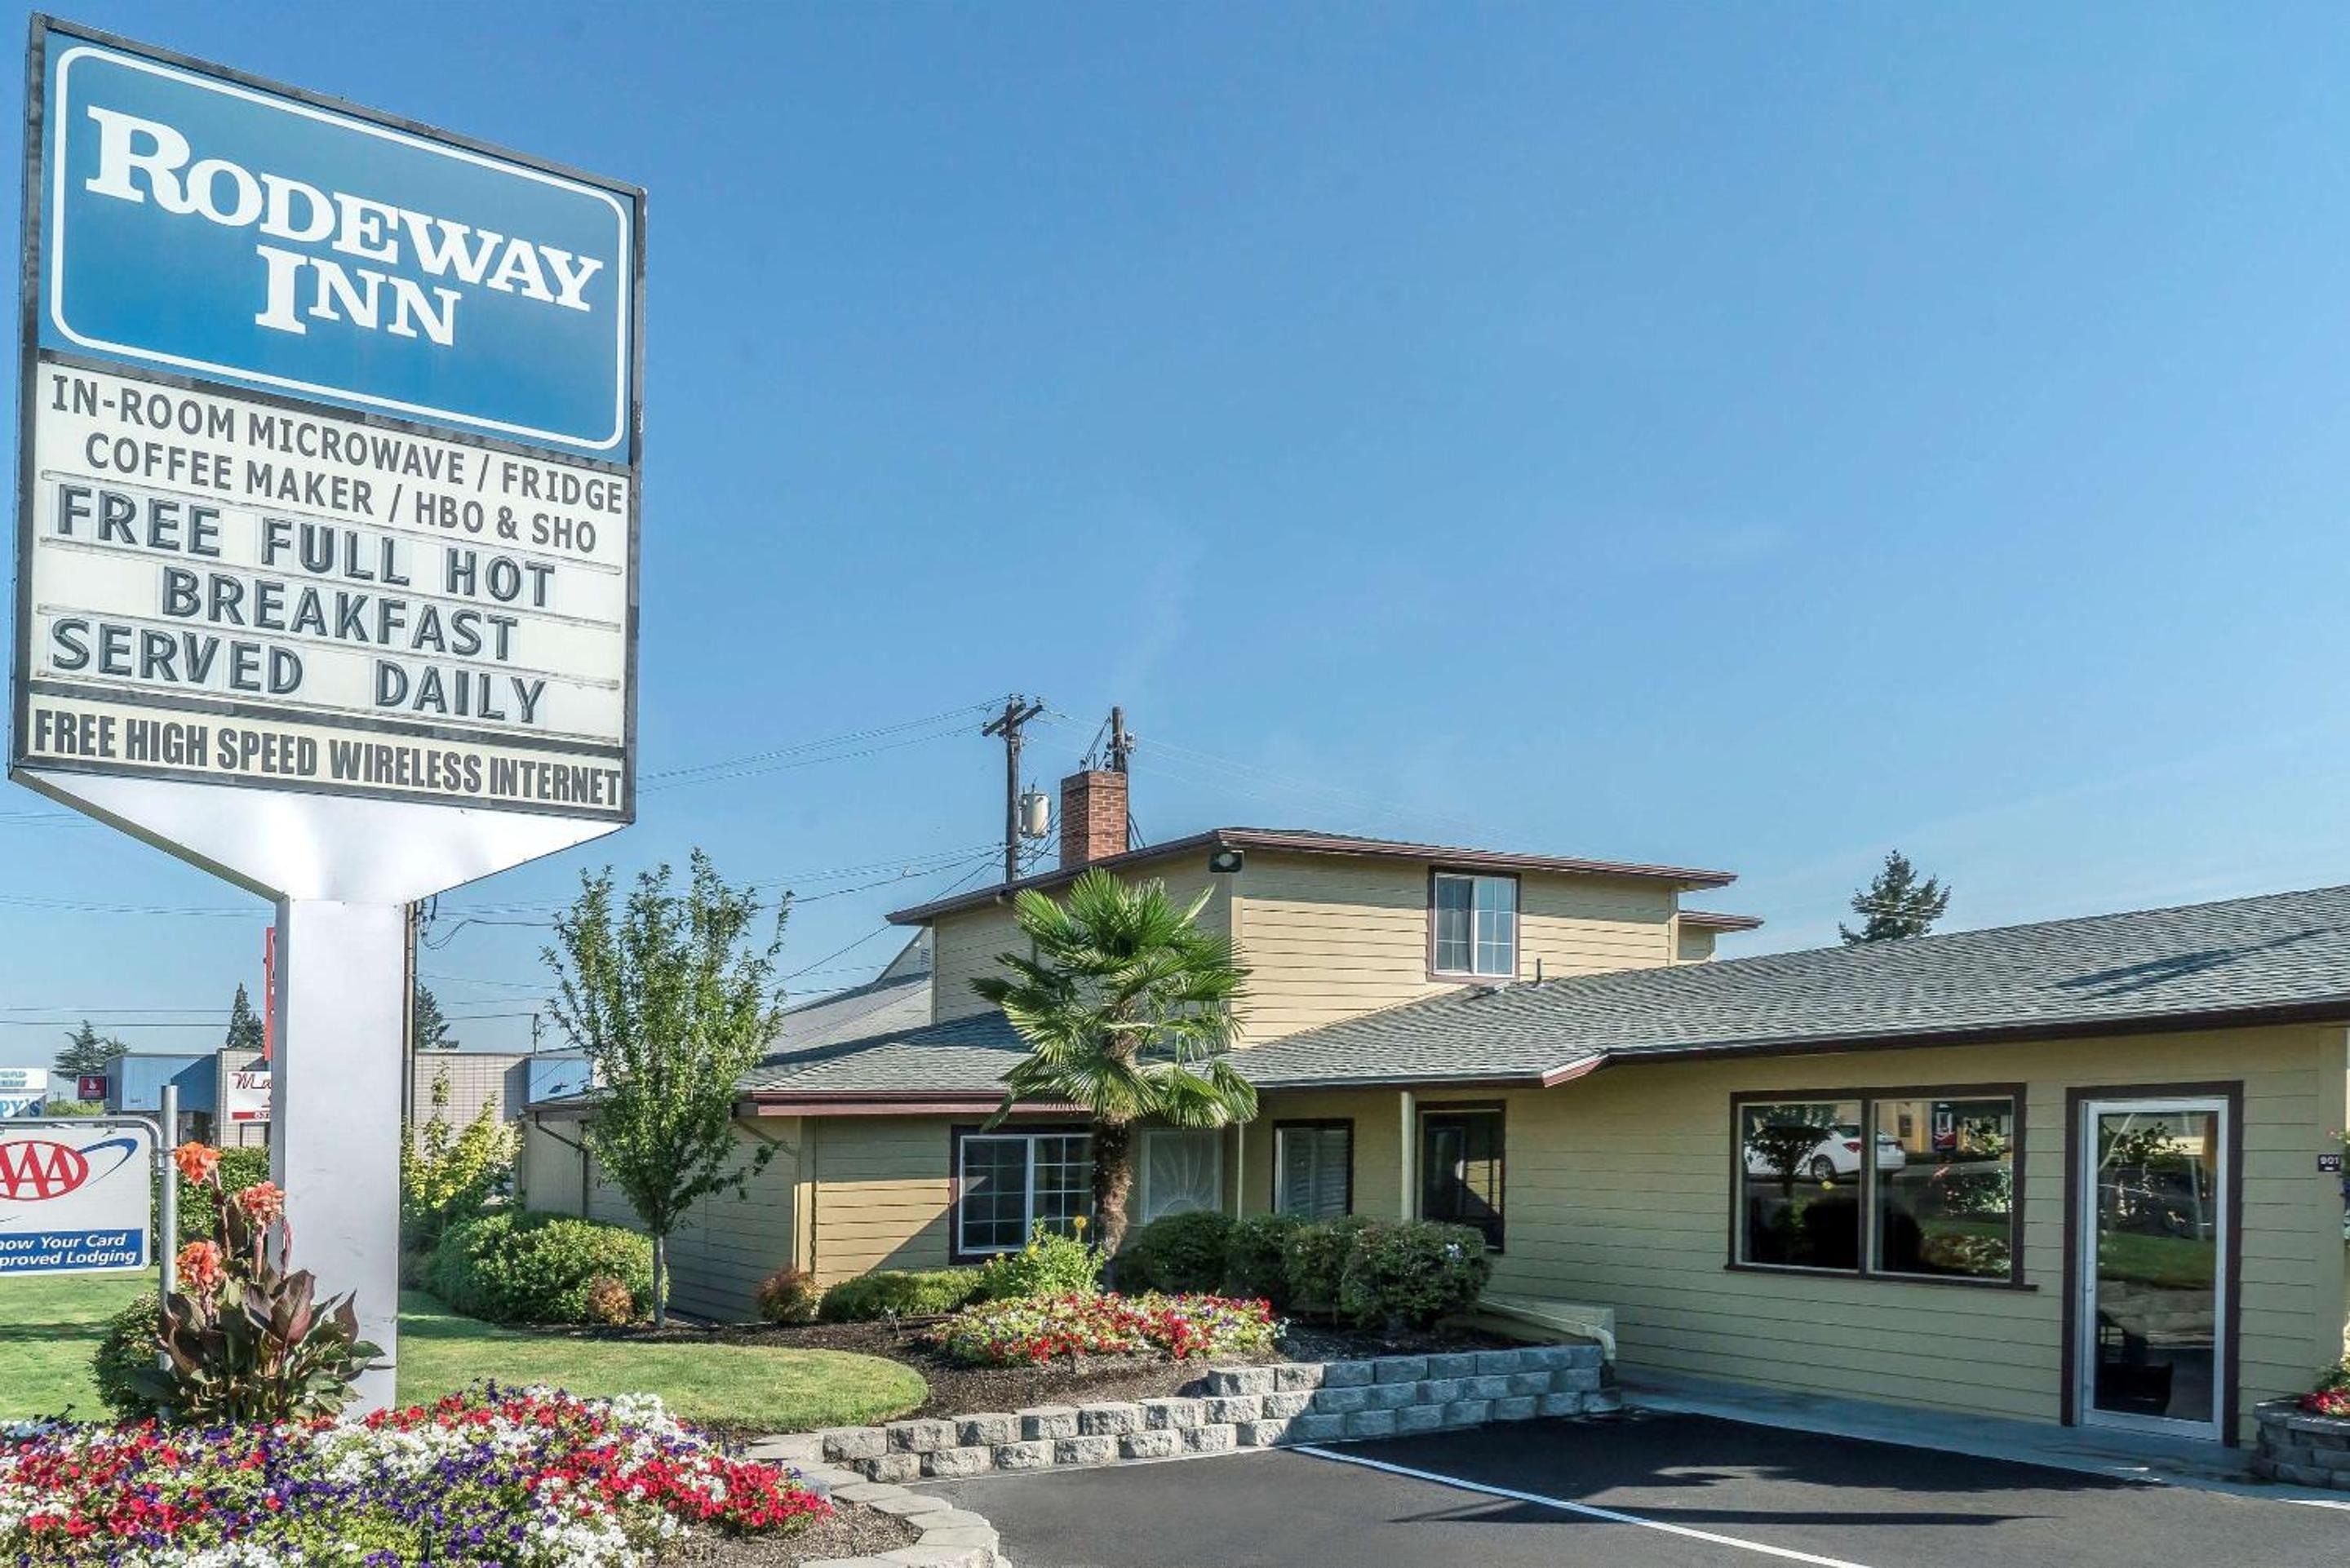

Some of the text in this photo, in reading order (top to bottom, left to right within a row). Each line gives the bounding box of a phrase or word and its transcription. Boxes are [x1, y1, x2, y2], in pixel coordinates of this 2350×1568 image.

[86, 104, 603, 312] RODEWAY
[255, 244, 461, 347] INN
[51, 374, 235, 443] IN-ROOM
[247, 414, 464, 490] MICROWAVE
[501, 460, 623, 515] FRIDGE
[85, 432, 232, 489] COFFEE
[246, 463, 375, 516] MAKER
[415, 496, 484, 534] HBO
[496, 506, 519, 540] &
[532, 514, 596, 553] SHO
[56, 483, 556, 608] FREE FULL HOT
[162, 566, 519, 662] BREAKFAST
[53, 618, 547, 724] SERVED DAILY
[34, 708, 622, 807] FREE HIGH SPEED WIRELESS INTERNET
[41, 1236, 82, 1249] Your
[86, 1233, 127, 1247] Card
[65, 1249, 137, 1265] Lodging
